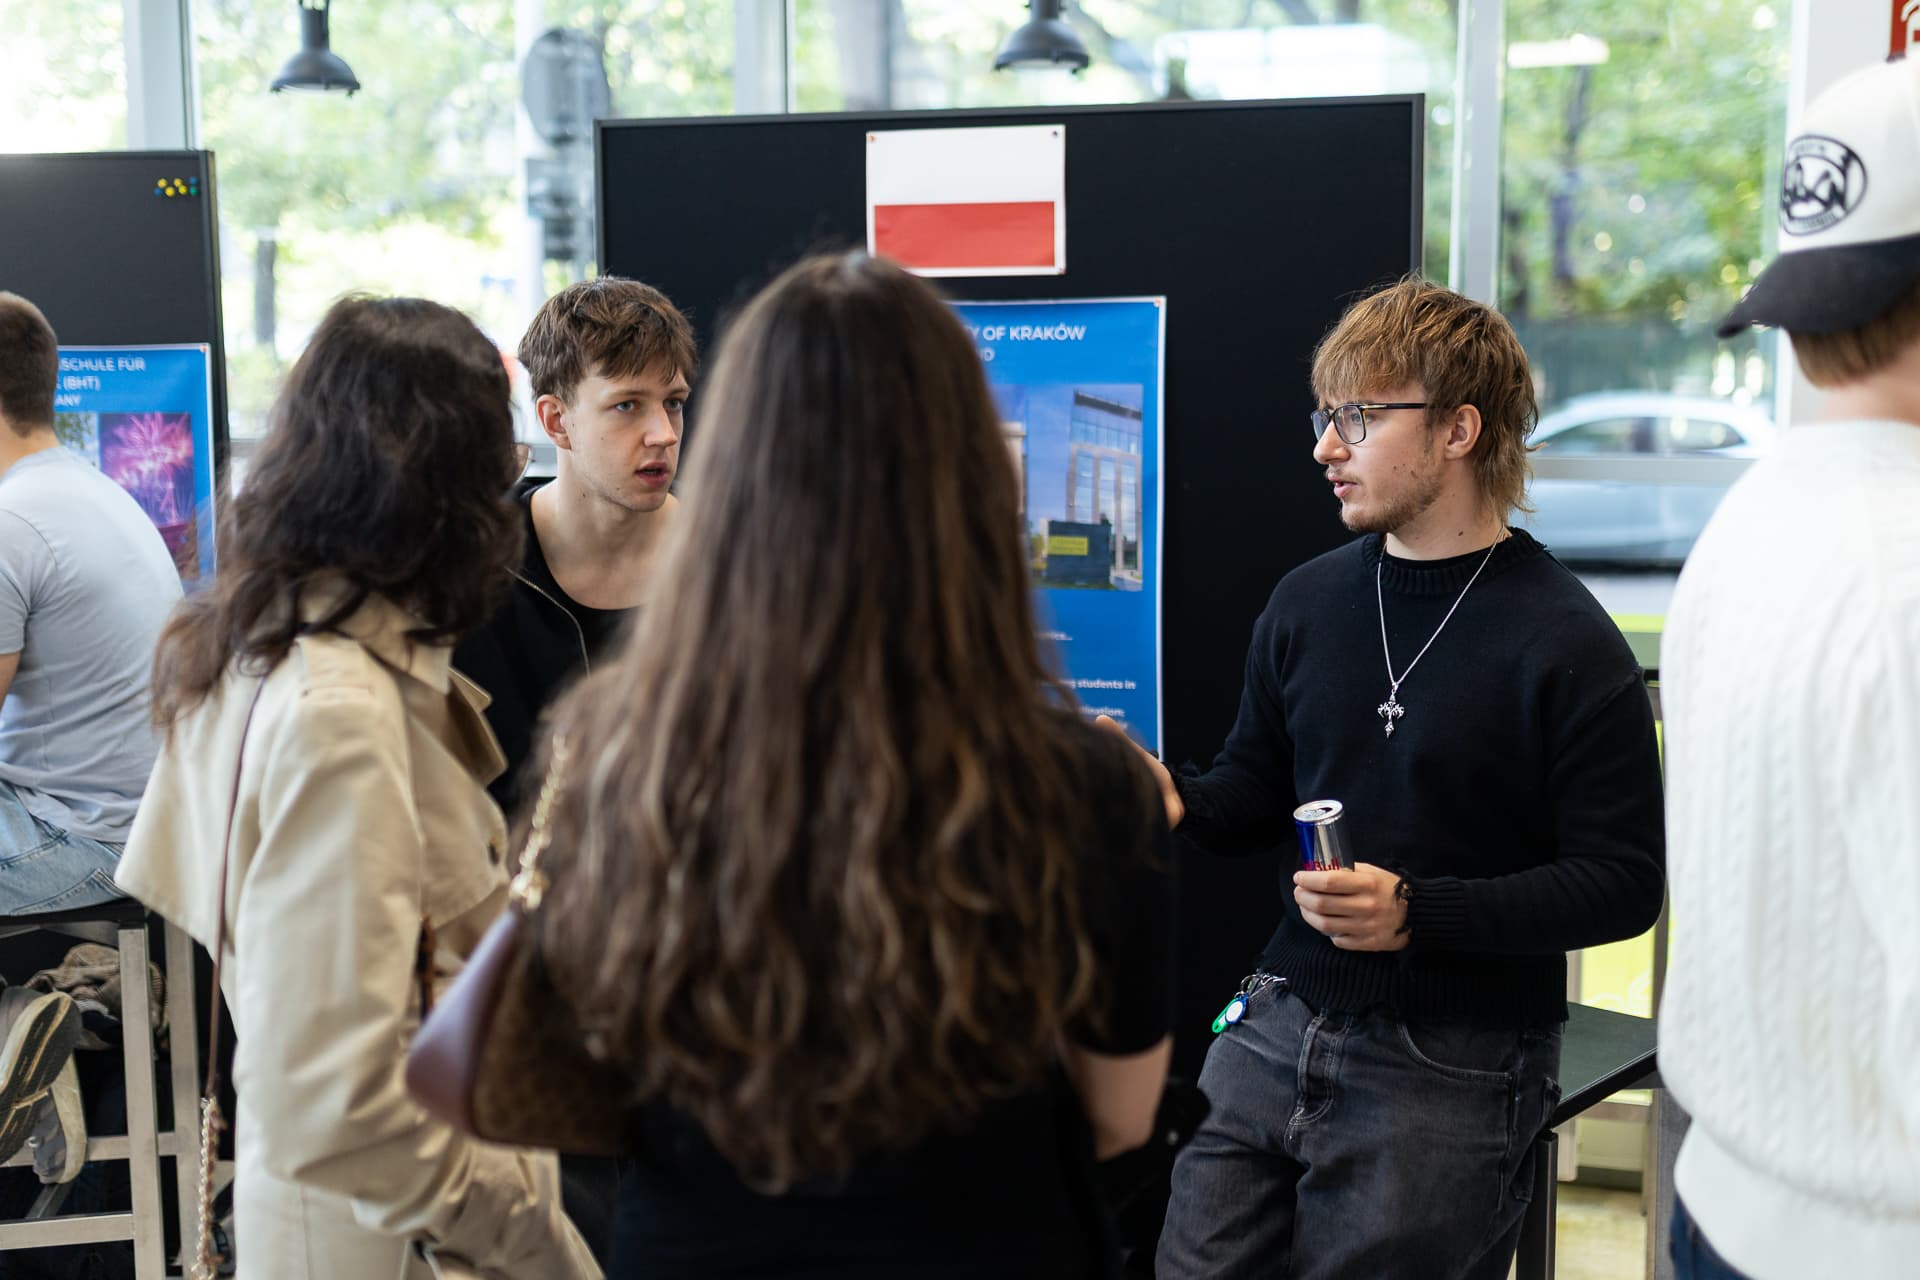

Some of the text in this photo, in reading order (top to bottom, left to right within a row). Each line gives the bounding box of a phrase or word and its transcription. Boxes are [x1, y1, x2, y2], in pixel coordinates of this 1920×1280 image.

[982, 326, 1006, 340] OF
[1009, 322, 1086, 340] KRAKÓW
[59, 357, 115, 371] SCHULE
[1078, 678, 1123, 689] students
[1125, 679, 1136, 690] in
